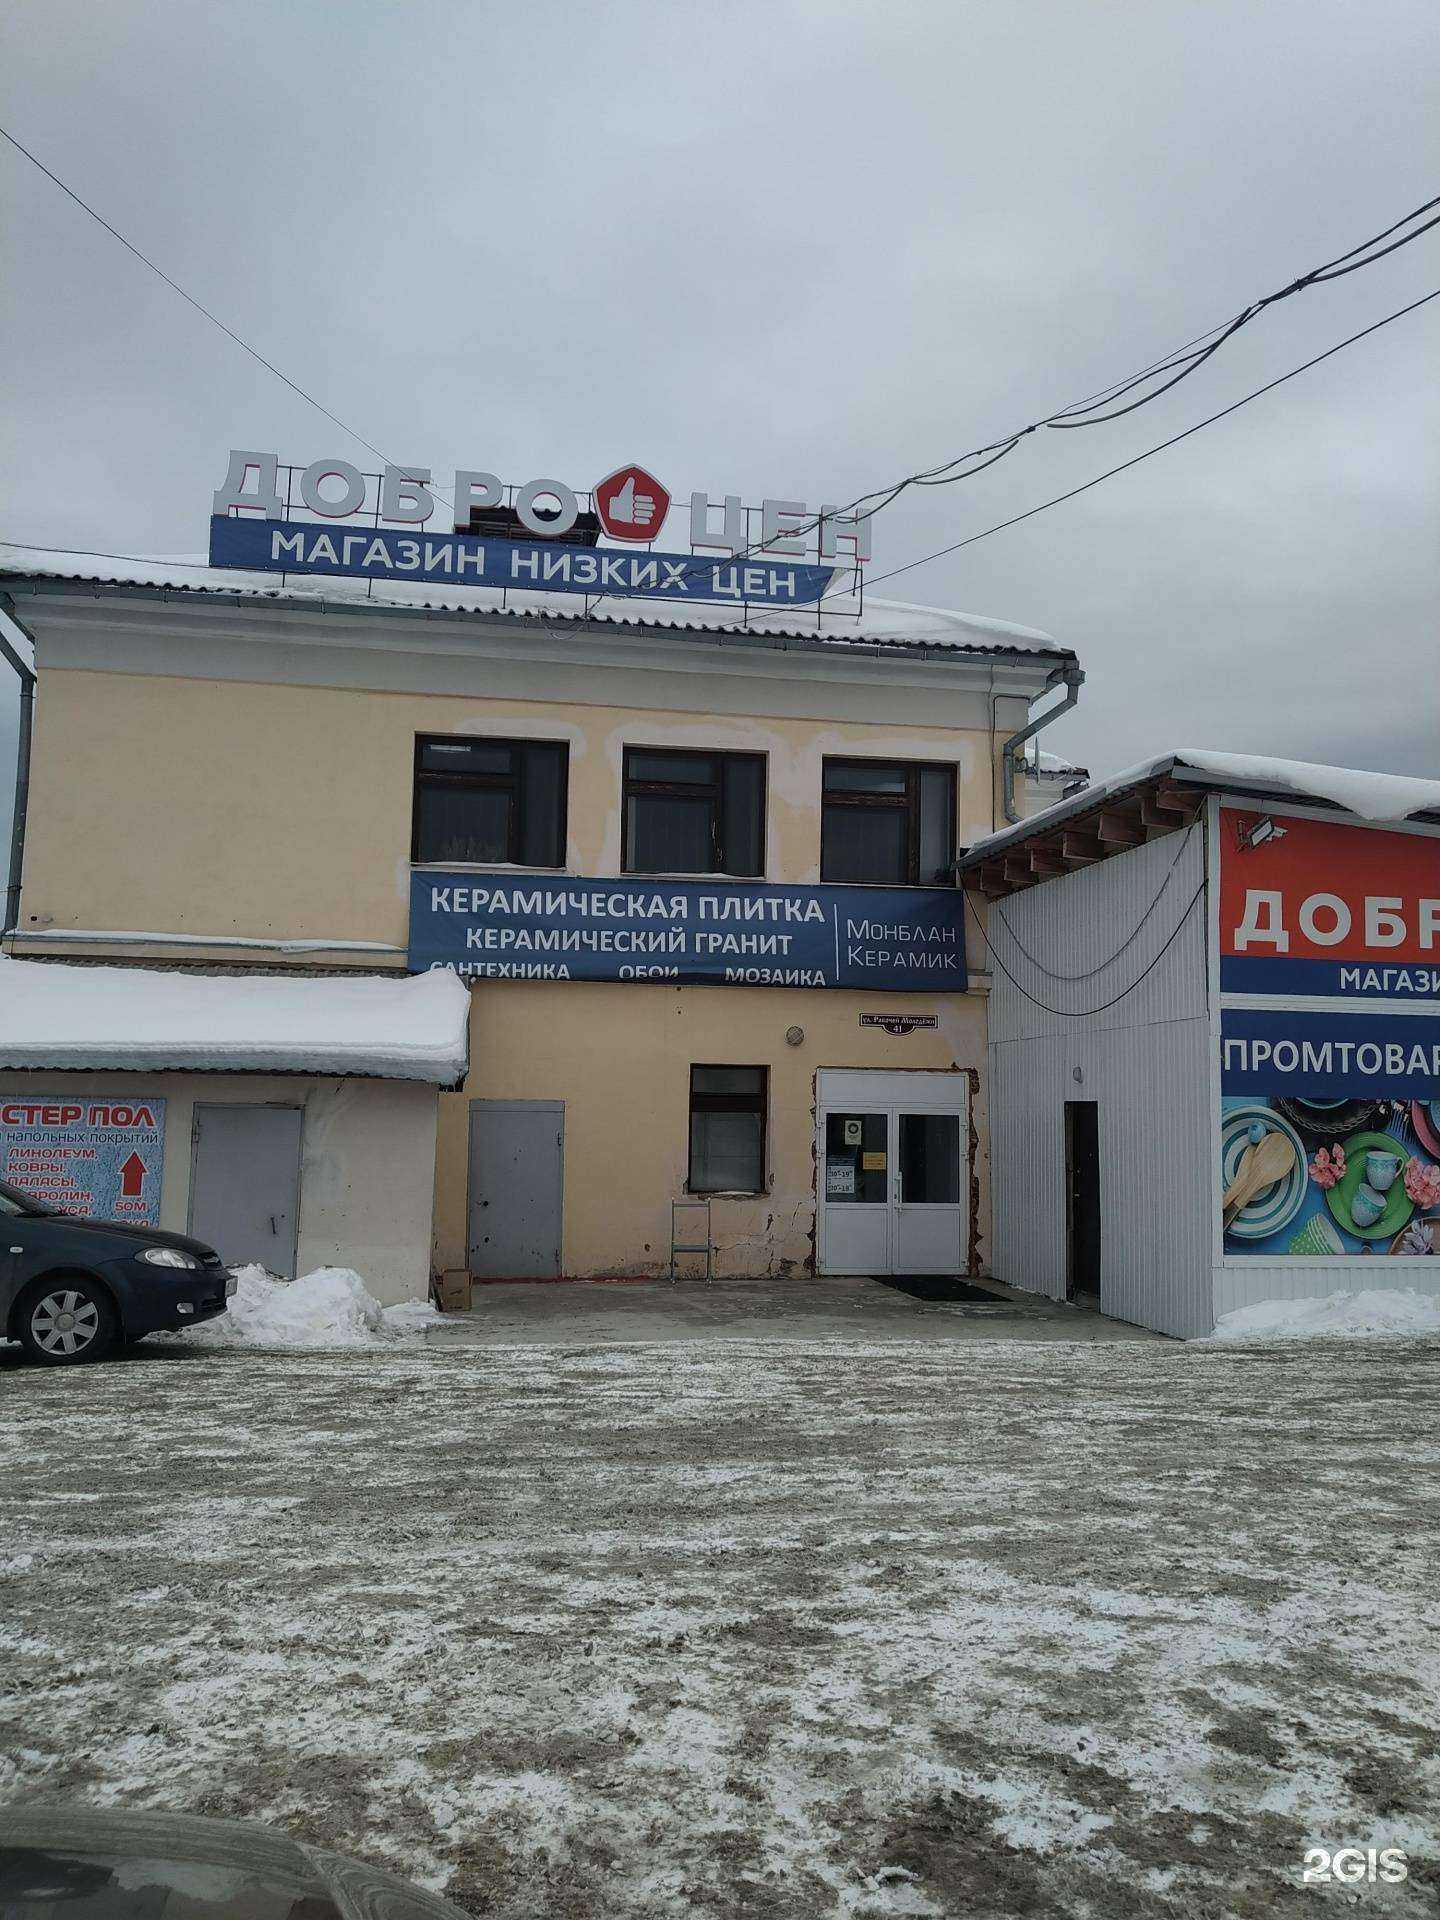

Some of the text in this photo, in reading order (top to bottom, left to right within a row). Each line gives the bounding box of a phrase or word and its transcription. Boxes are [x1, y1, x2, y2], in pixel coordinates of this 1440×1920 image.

[212, 449, 872, 562] ДОБРО ЦЕН
[270, 530, 796, 599] МАГАЗИН НИЗКИХ ЦЕН
[431, 887, 825, 923] КЕРАМИЧЕСКАЯ ПЛИТКА
[466, 926, 793, 955] КЕРАМИЧЕСКИЙ ГРАНИТ
[847, 919, 956, 942] МОНБЛАН
[848, 945, 958, 969] КЕРАМИК
[619, 965, 679, 978] ОБОИ
[725, 967, 826, 986] МОЗАИКА
[88, 1106, 154, 1127] ПОЛ
[7, 1131, 158, 1145] напольных покрытий
